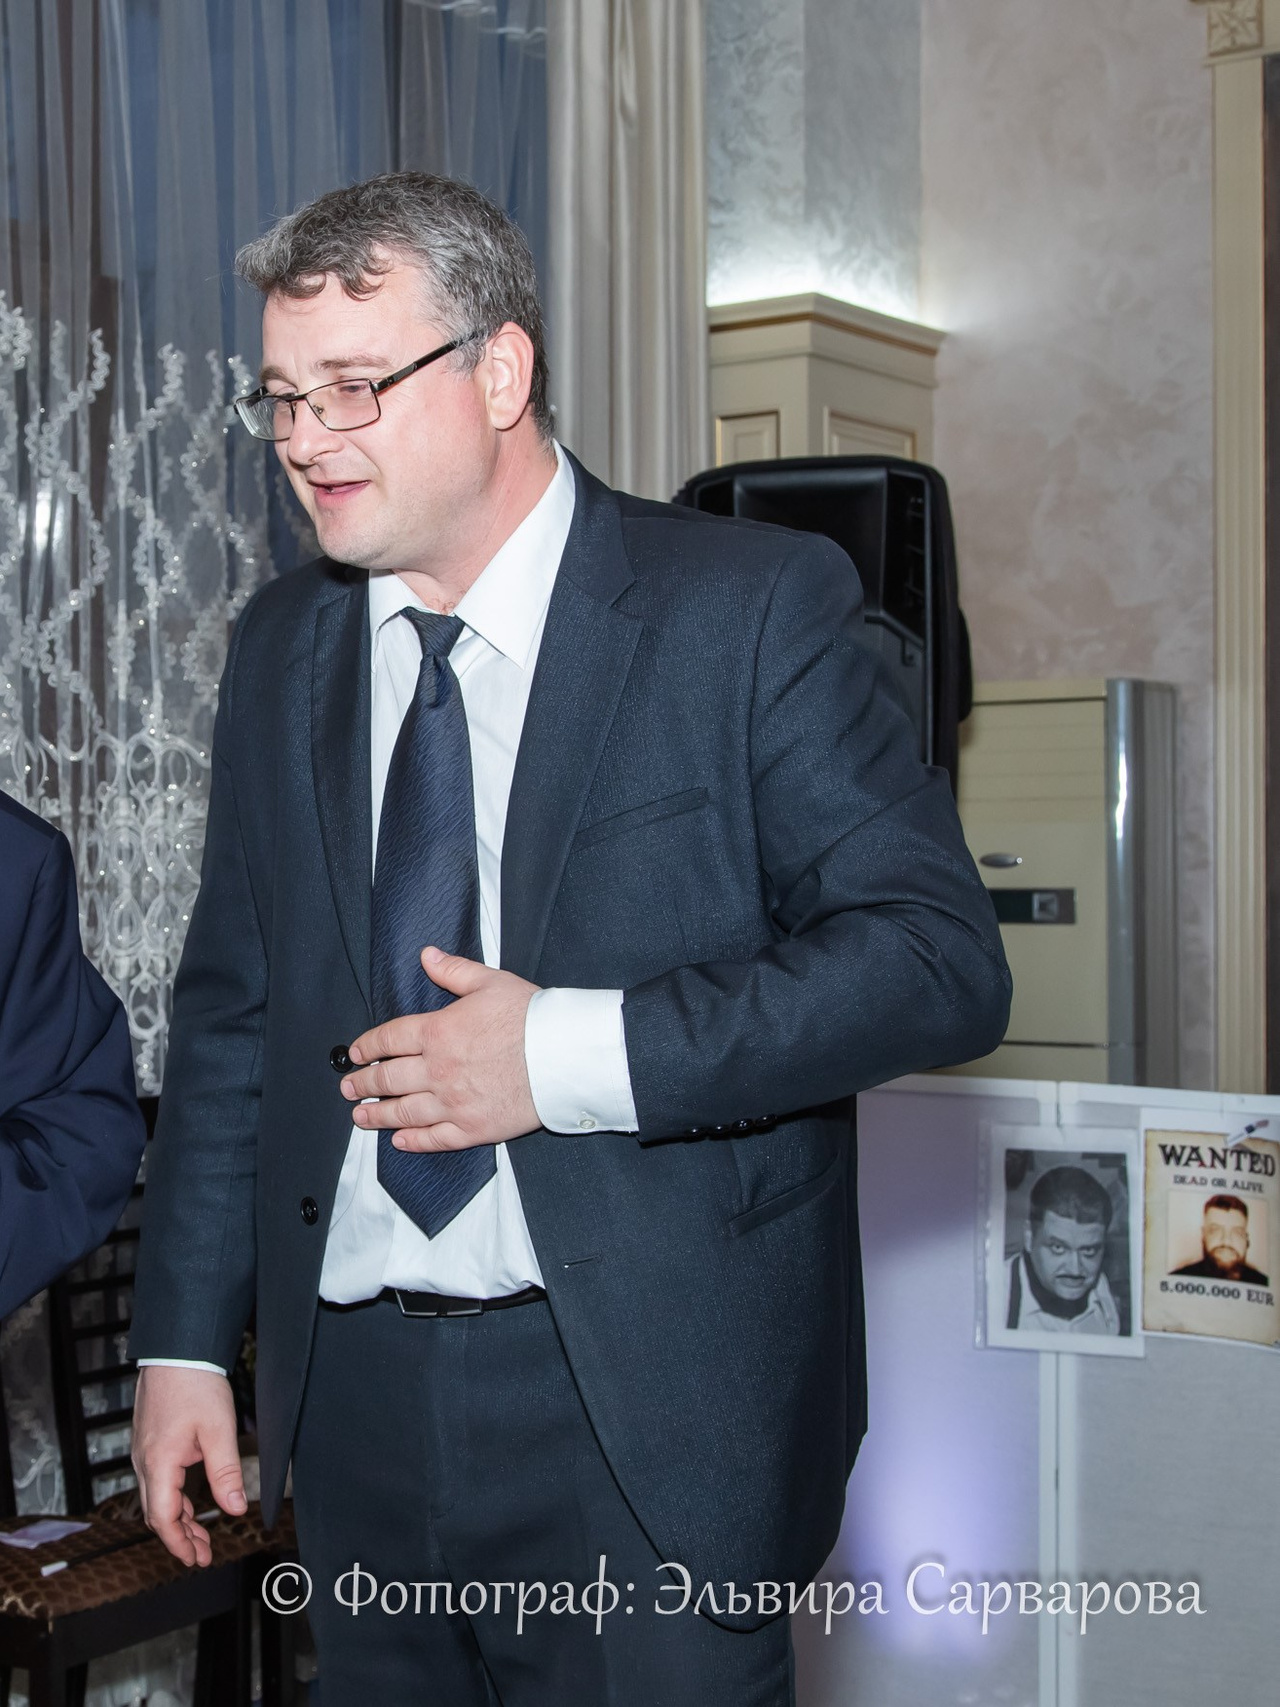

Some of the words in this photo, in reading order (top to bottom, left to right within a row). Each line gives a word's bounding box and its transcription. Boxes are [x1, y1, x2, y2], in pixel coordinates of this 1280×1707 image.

[1159, 1143, 1276, 1178] WANTED
[1173, 1174, 1208, 1187] DEAD
[1211, 1177, 1227, 1189] OR
[1232, 1179, 1265, 1194] ALIVE
[1160, 1280, 1241, 1300] 5.000.000
[1246, 1288, 1275, 1307] EUR
